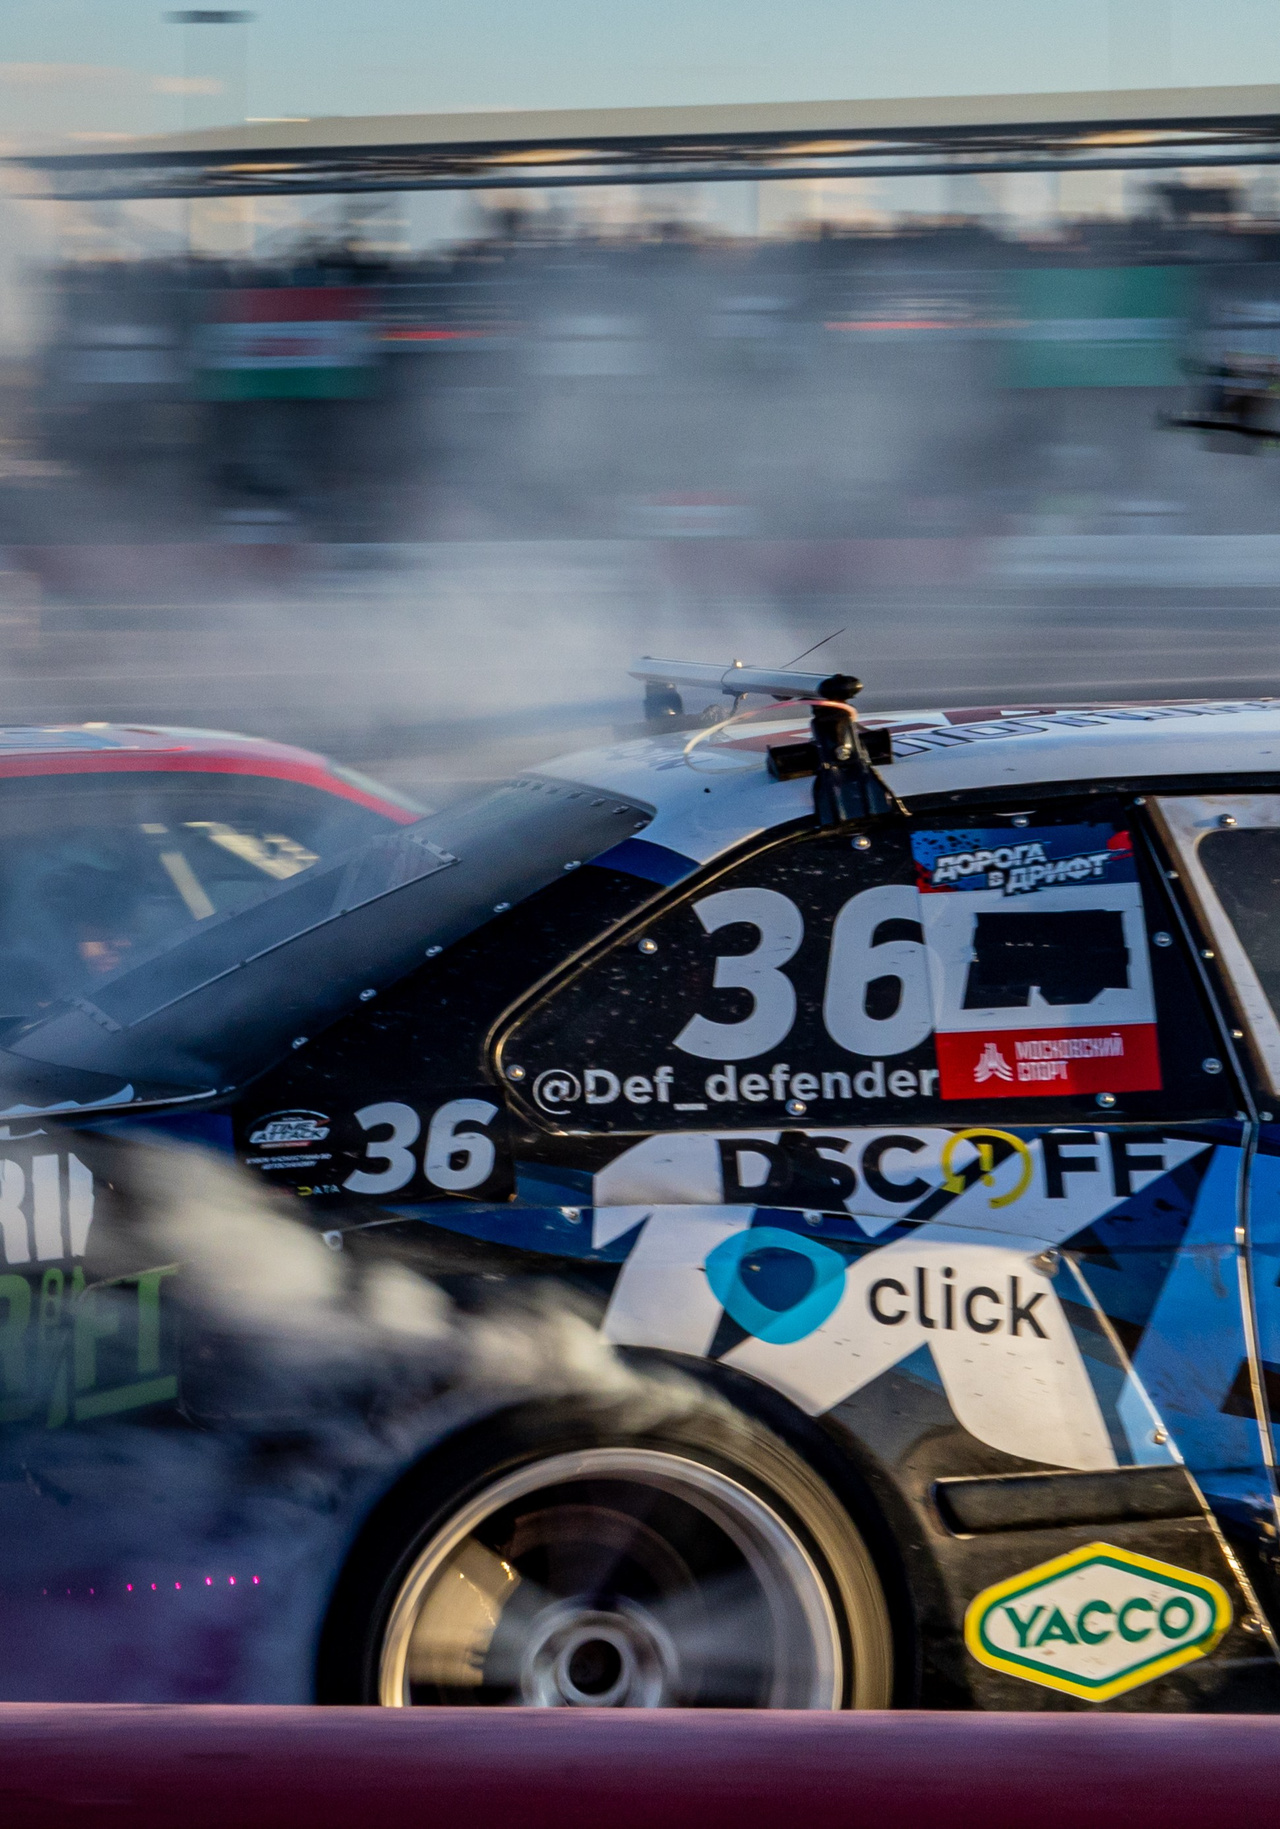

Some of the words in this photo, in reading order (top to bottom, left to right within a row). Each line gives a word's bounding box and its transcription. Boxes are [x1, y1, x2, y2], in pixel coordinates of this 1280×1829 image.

[932, 843, 1047, 884] ДОРОГА
[1003, 852, 1112, 895] ДРИФТ
[671, 884, 936, 1061] 36
[1015, 1032, 1124, 1060] МОСКОВСКИЙ
[1016, 1060, 1068, 1082] СПОРТ
[532, 1061, 939, 1115] @Def_defender
[342, 1098, 499, 1194] 36
[869, 1265, 1050, 1339] click
[1002, 1596, 1195, 1648] YACCO
